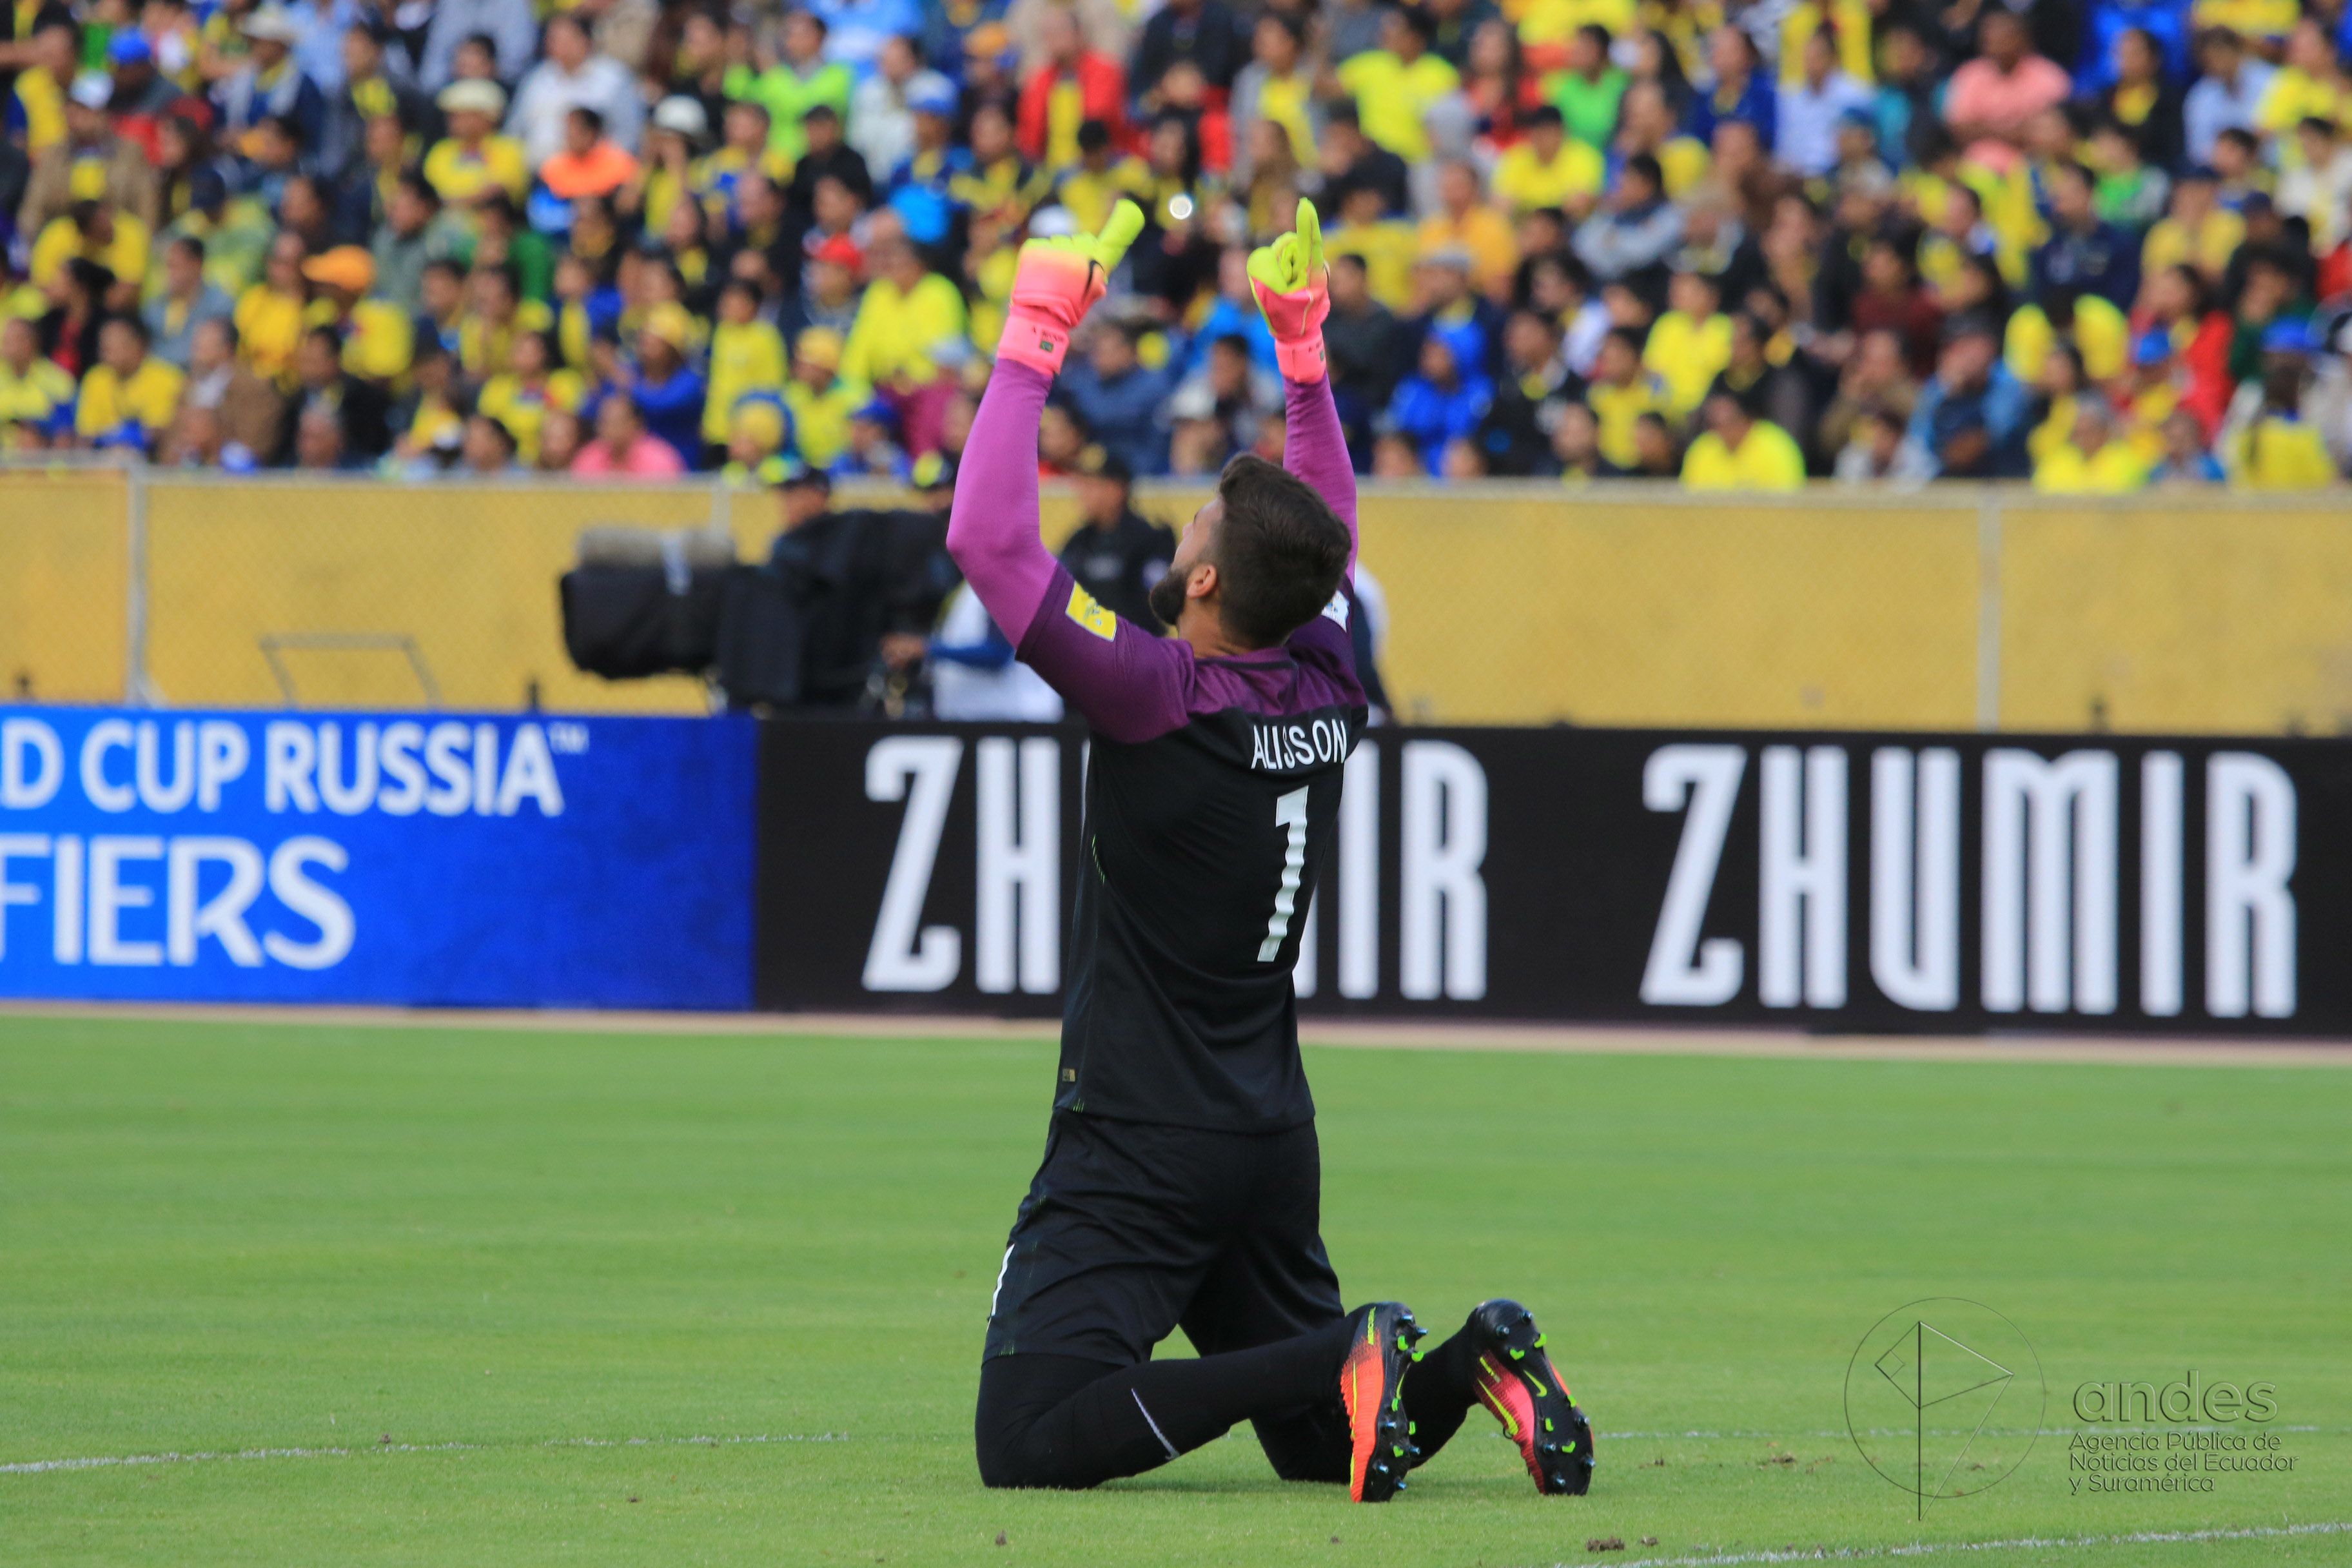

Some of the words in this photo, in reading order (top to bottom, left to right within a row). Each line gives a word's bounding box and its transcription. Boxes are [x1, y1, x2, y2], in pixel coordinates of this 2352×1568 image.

[79, 718, 251, 814] CUP
[1251, 719, 1347, 769] ALISSON
[861, 734, 1489, 1001] ZHIR
[1257, 785, 1309, 962] 1
[1639, 743, 2298, 1019] ZHUMIR
